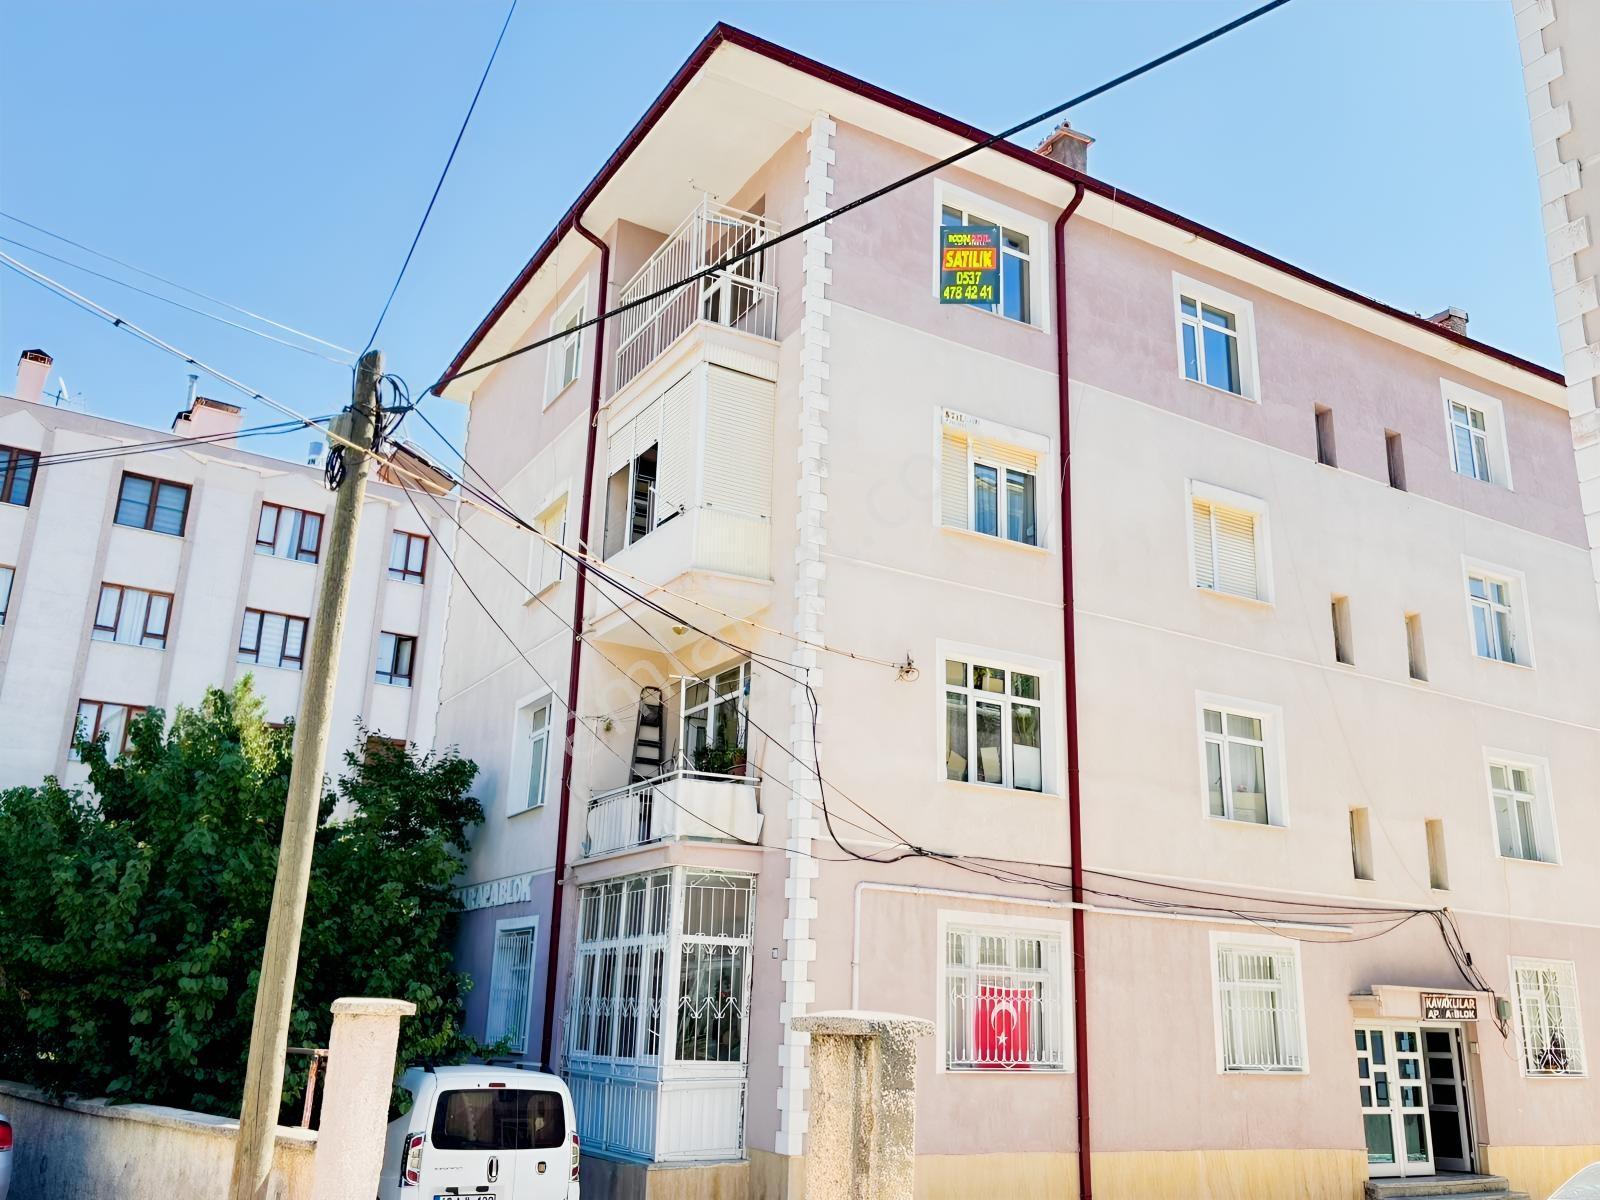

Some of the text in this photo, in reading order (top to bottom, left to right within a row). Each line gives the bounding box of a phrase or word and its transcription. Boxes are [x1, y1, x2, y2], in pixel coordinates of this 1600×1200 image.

[945, 250, 993, 268] SATILIK
[956, 271, 982, 285] 0537
[943, 285, 992, 299] 478 42 41
